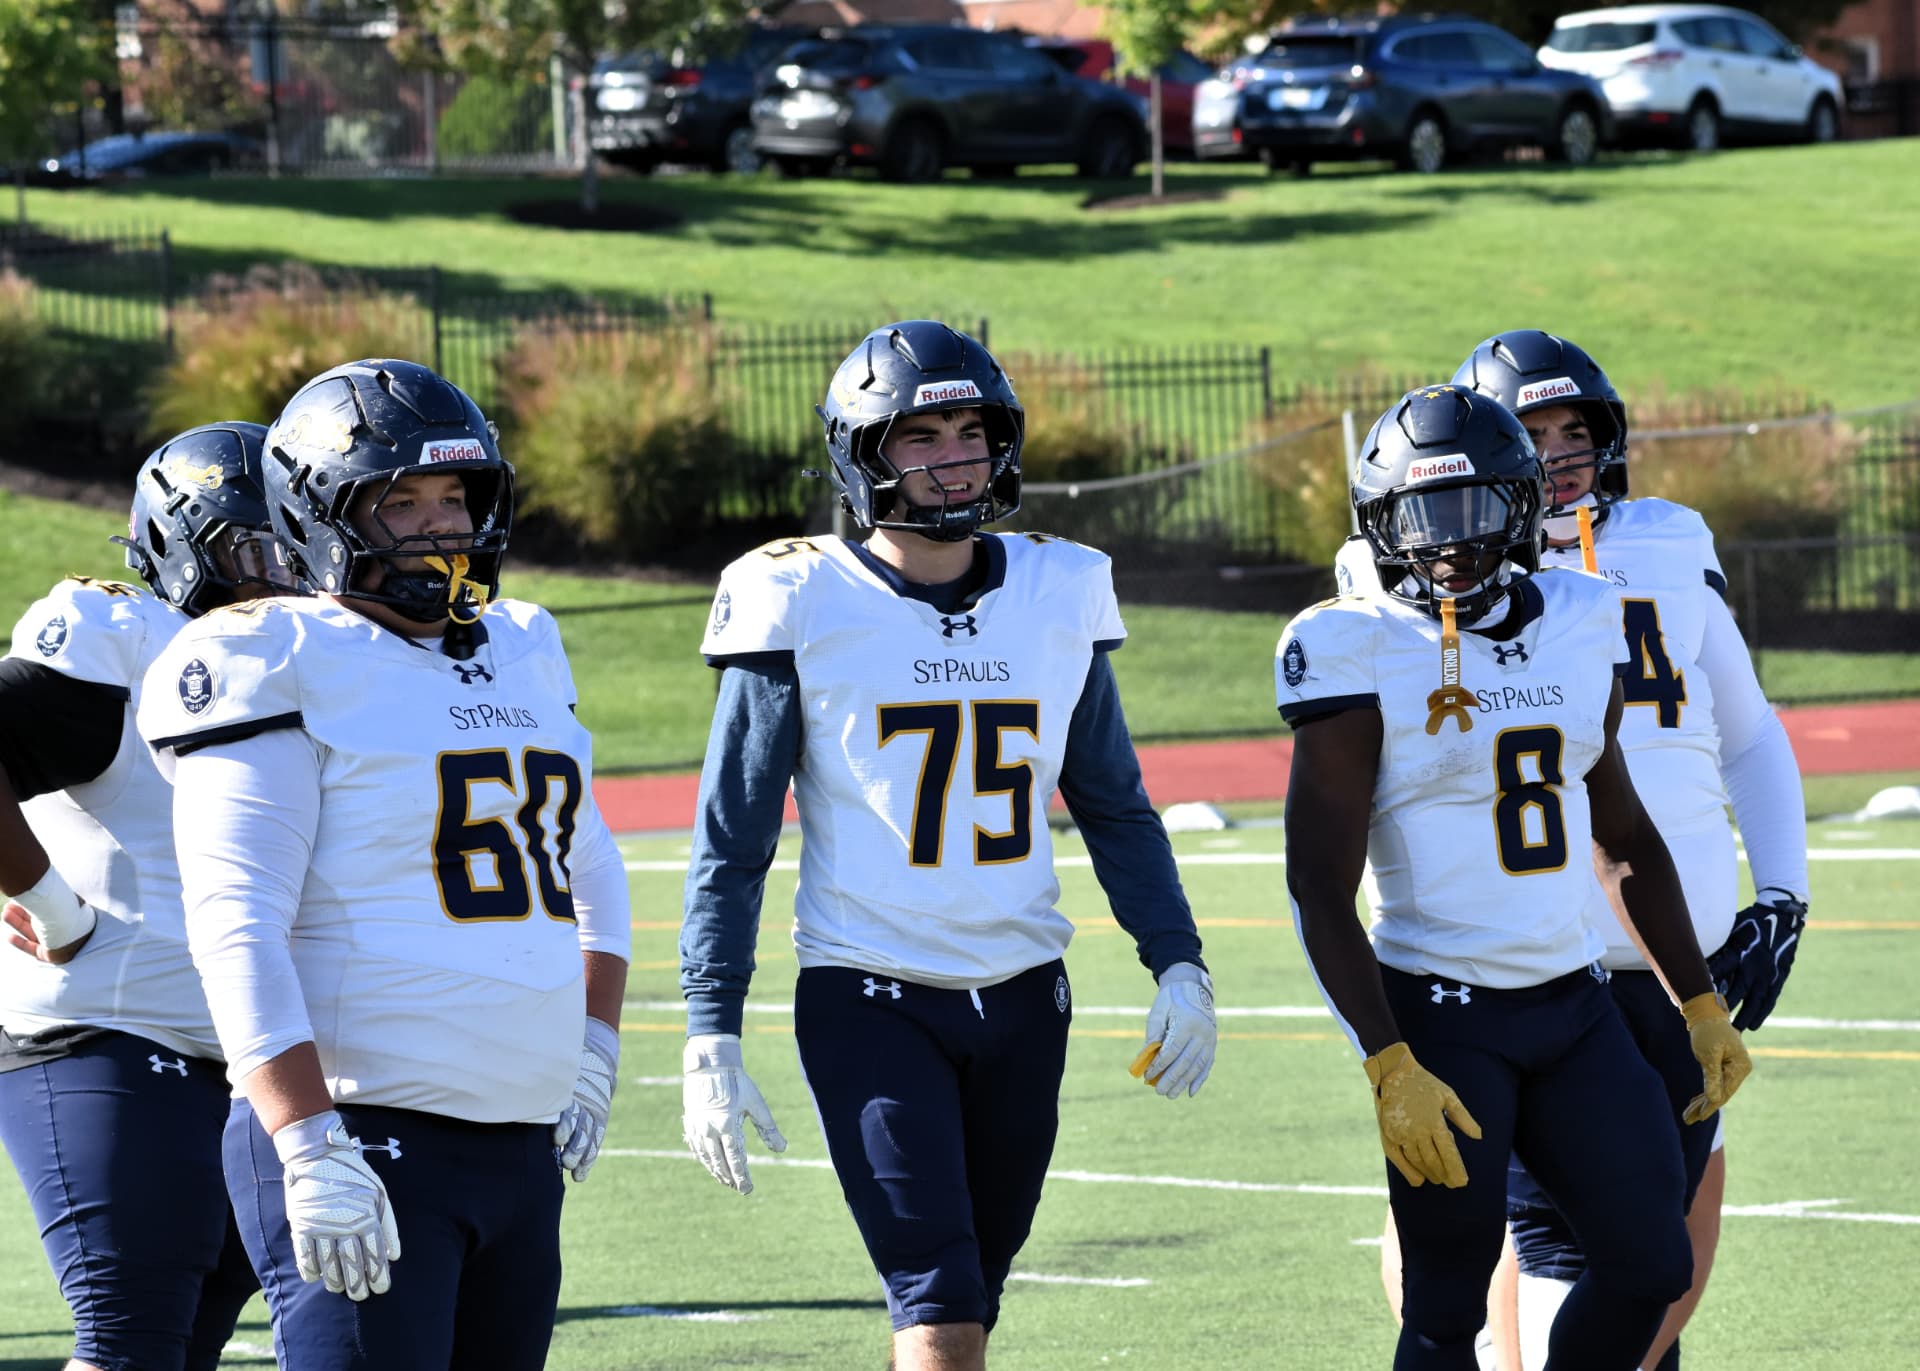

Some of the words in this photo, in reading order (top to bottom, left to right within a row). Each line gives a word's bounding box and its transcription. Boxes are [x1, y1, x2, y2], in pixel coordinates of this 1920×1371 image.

[921, 385, 977, 402] Riddell
[1523, 382, 1575, 402] Riddell
[429, 445, 482, 462] Riddell
[1411, 460, 1468, 479] Riddell
[1443, 648, 1458, 686] NXTRND
[876, 699, 1040, 868] 75
[1492, 723, 1569, 877] 8
[431, 745, 583, 924] 60
